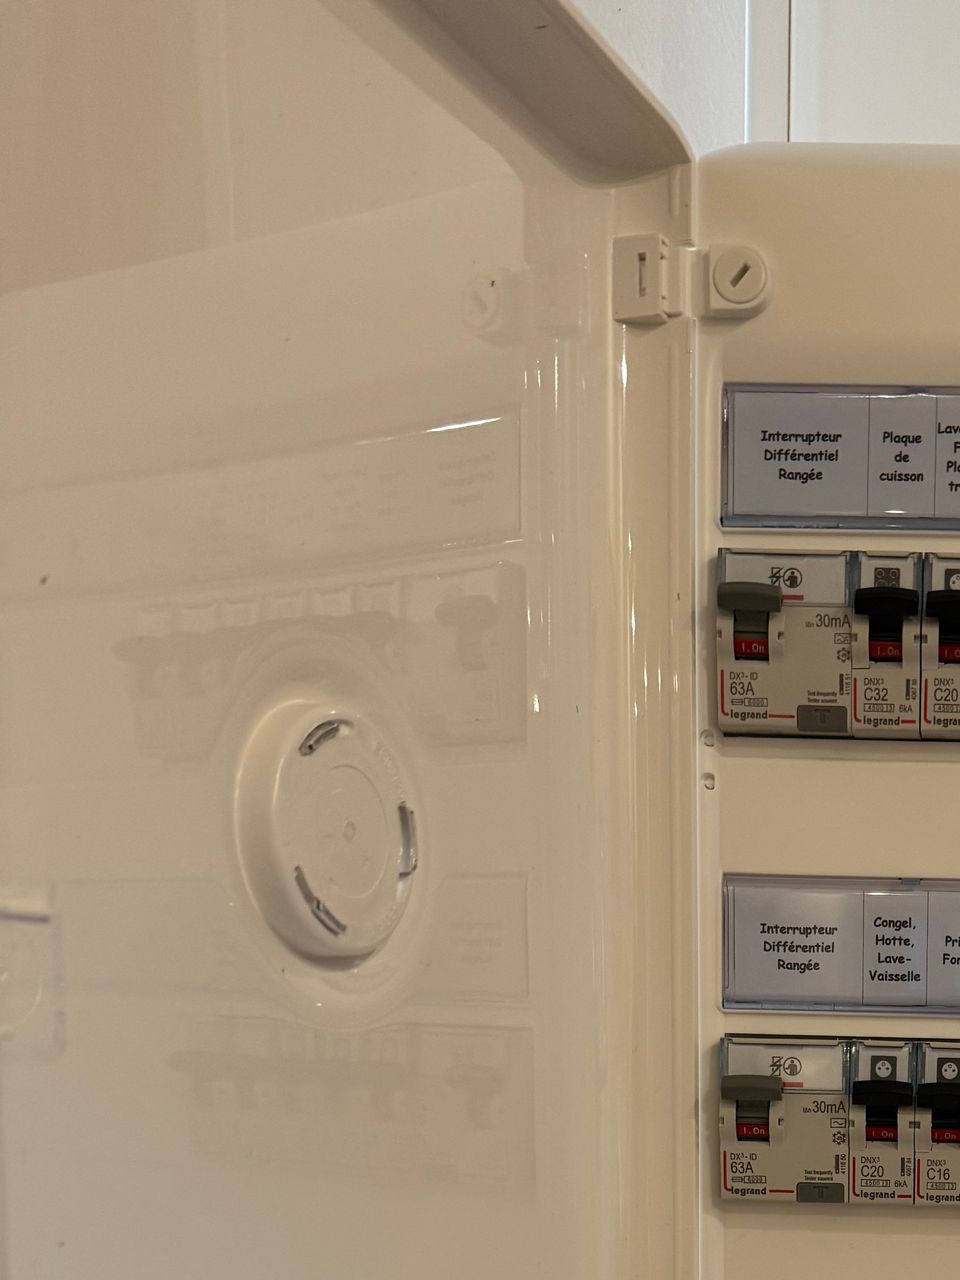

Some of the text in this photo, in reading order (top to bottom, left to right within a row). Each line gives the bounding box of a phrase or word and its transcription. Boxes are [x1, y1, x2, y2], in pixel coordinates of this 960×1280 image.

[761, 430, 842, 445] Interrupteur
[882, 431, 922, 447] Plaque
[764, 449, 839, 462] Différentiel
[894, 451, 910, 463] de
[778, 468, 823, 484] Rangée
[879, 470, 924, 482] cuisson
[815, 614, 851, 628] 30mA
[730, 682, 755, 696] 63A
[863, 688, 889, 702] C32
[933, 688, 959, 702] C20
[730, 710, 768, 724] legrand
[863, 715, 900, 727] legrand
[760, 922, 838, 938] Interrupteur
[873, 916, 916, 932] Congel,
[763, 941, 835, 953] Différentiel
[875, 935, 915, 948] Hotte,
[877, 952, 912, 964] Lave-
[777, 959, 820, 974] Rangée
[868, 970, 921, 982] Vaisselle
[812, 1100, 846, 1113] 30mA
[730, 1161, 754, 1174] 63A
[860, 1165, 884, 1178] C20
[926, 1168, 950, 1180] C16
[730, 1186, 767, 1196] legrand
[860, 1190, 896, 1200] legrand
[926, 1193, 960, 1202] legrand
